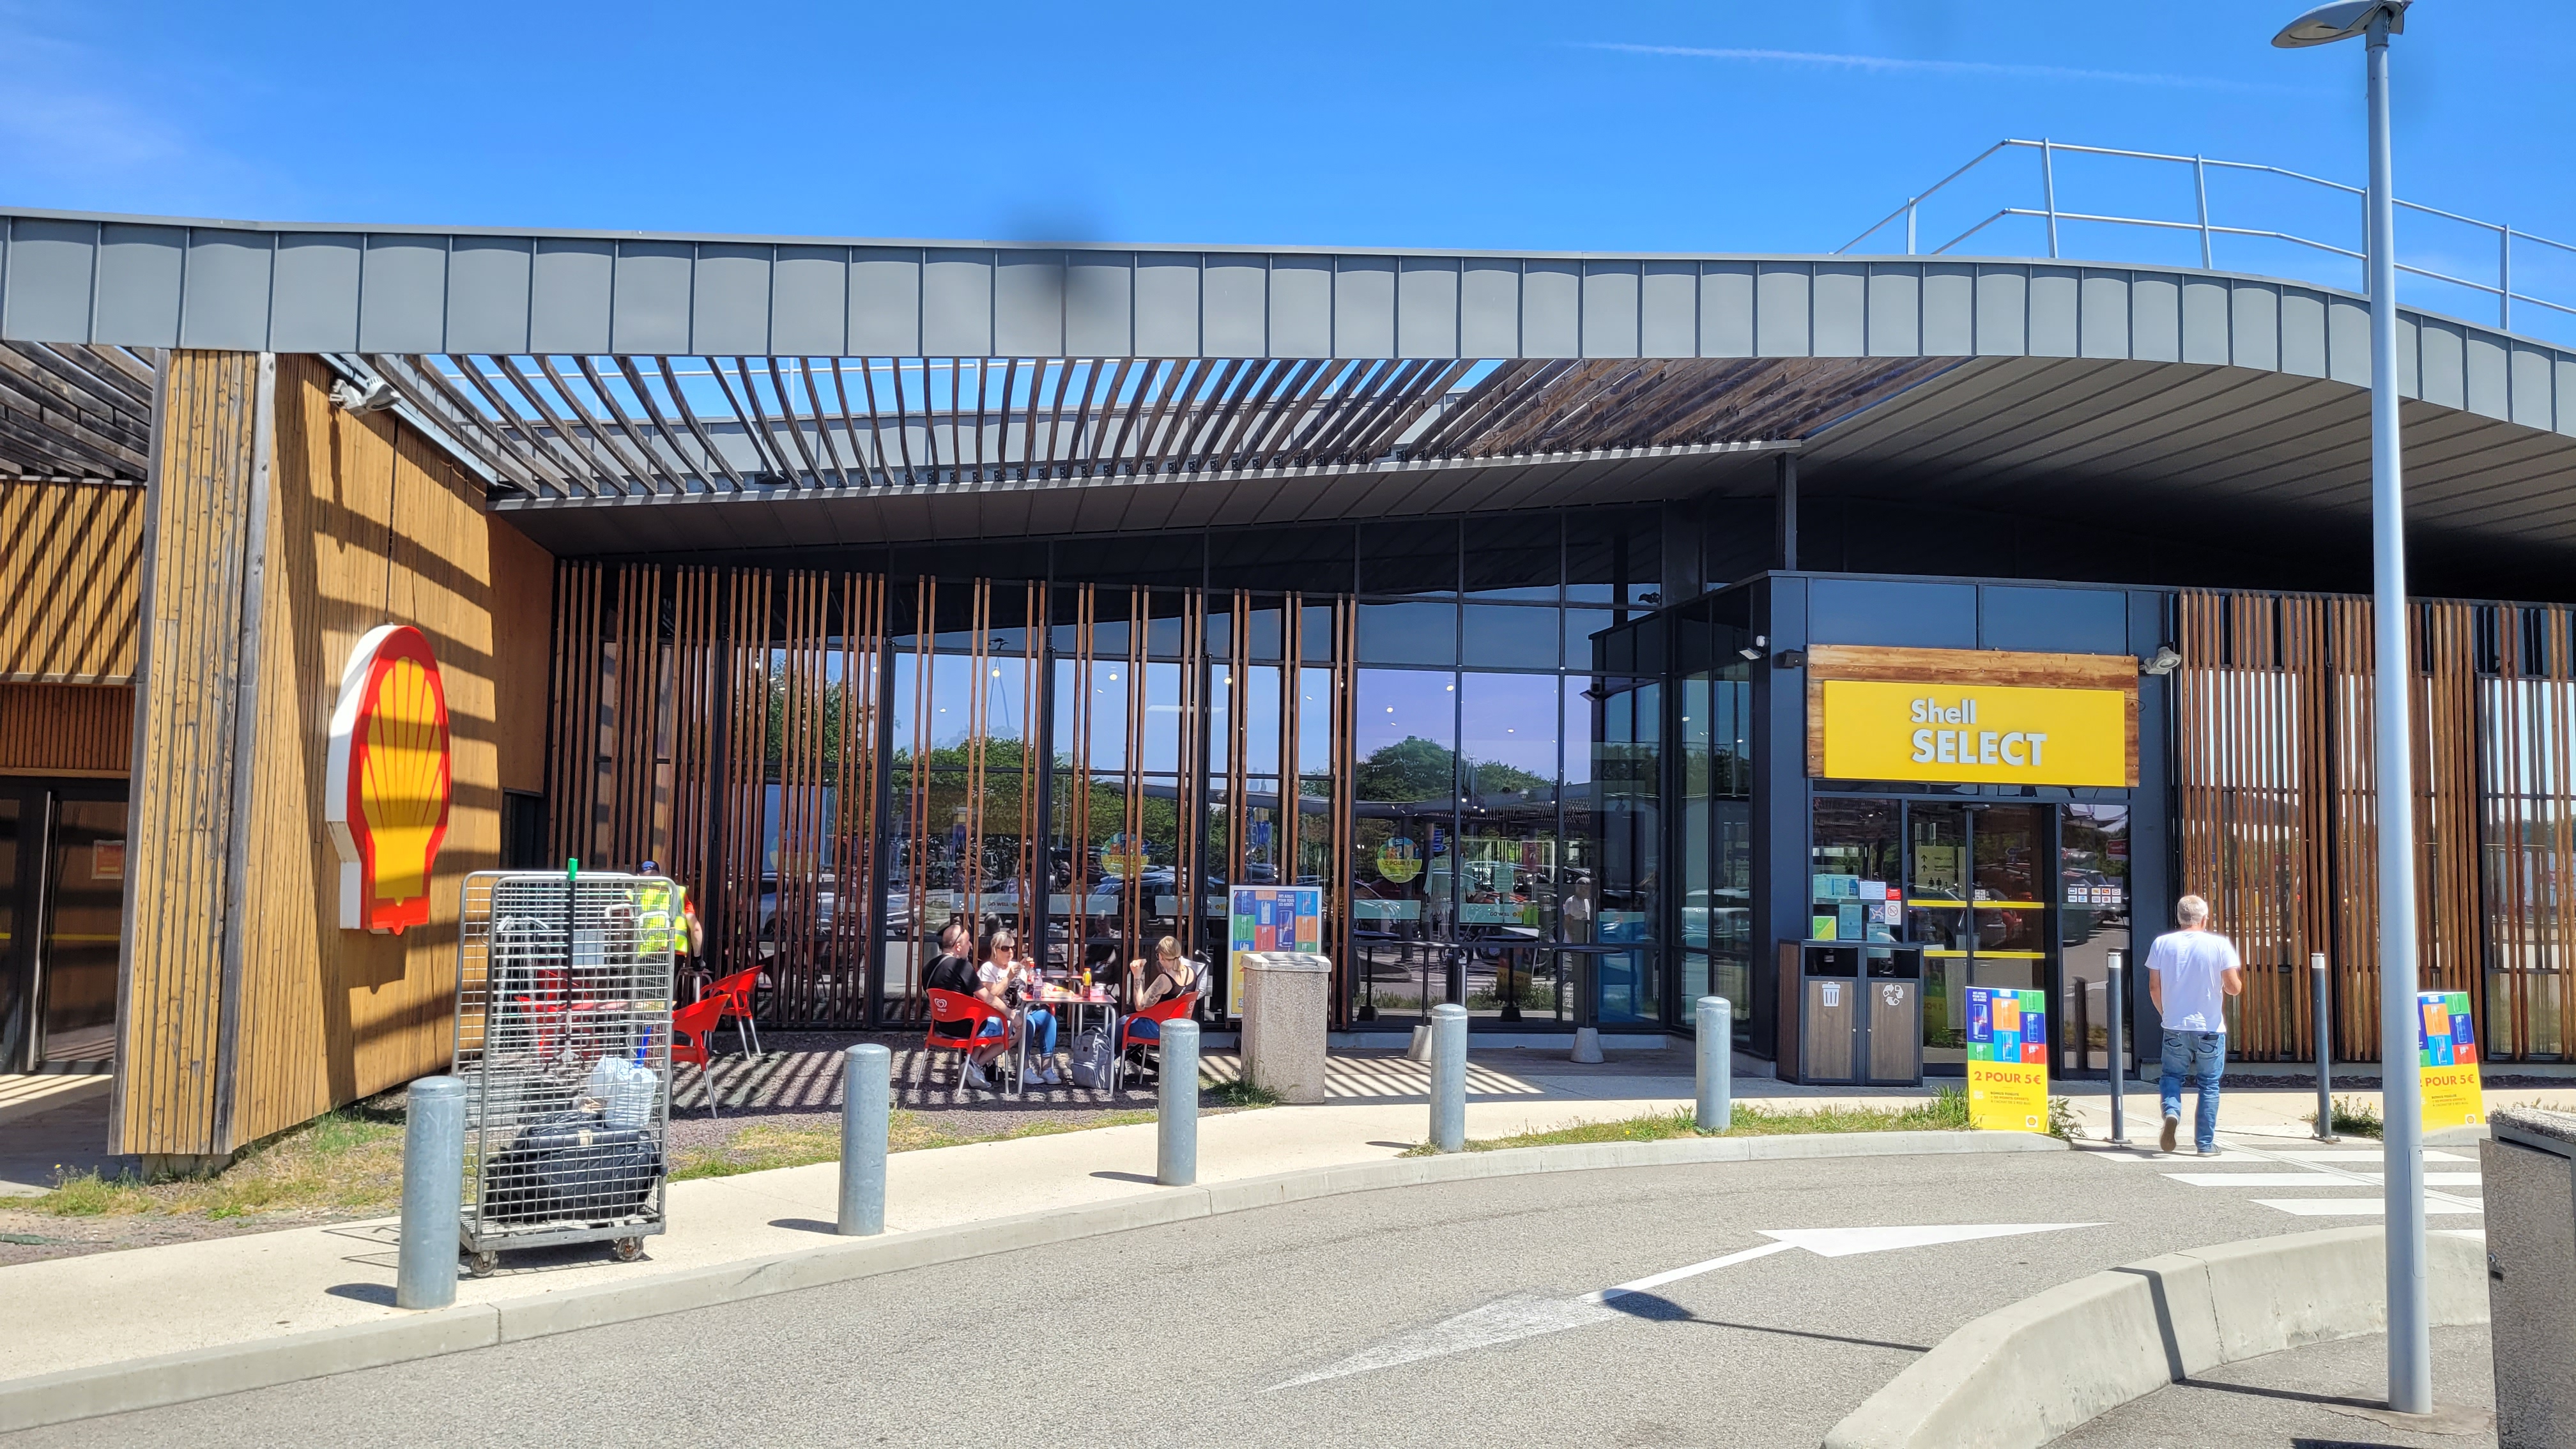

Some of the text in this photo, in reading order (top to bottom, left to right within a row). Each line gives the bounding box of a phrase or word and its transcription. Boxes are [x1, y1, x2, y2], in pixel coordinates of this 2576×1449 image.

[1911, 697, 1976, 724] Shell
[1912, 728, 2047, 766] SELECT
[1974, 1071, 1982, 1081] 2
[1986, 1071, 2021, 1084] POUR
[2425, 1075, 2457, 1087] POUR
